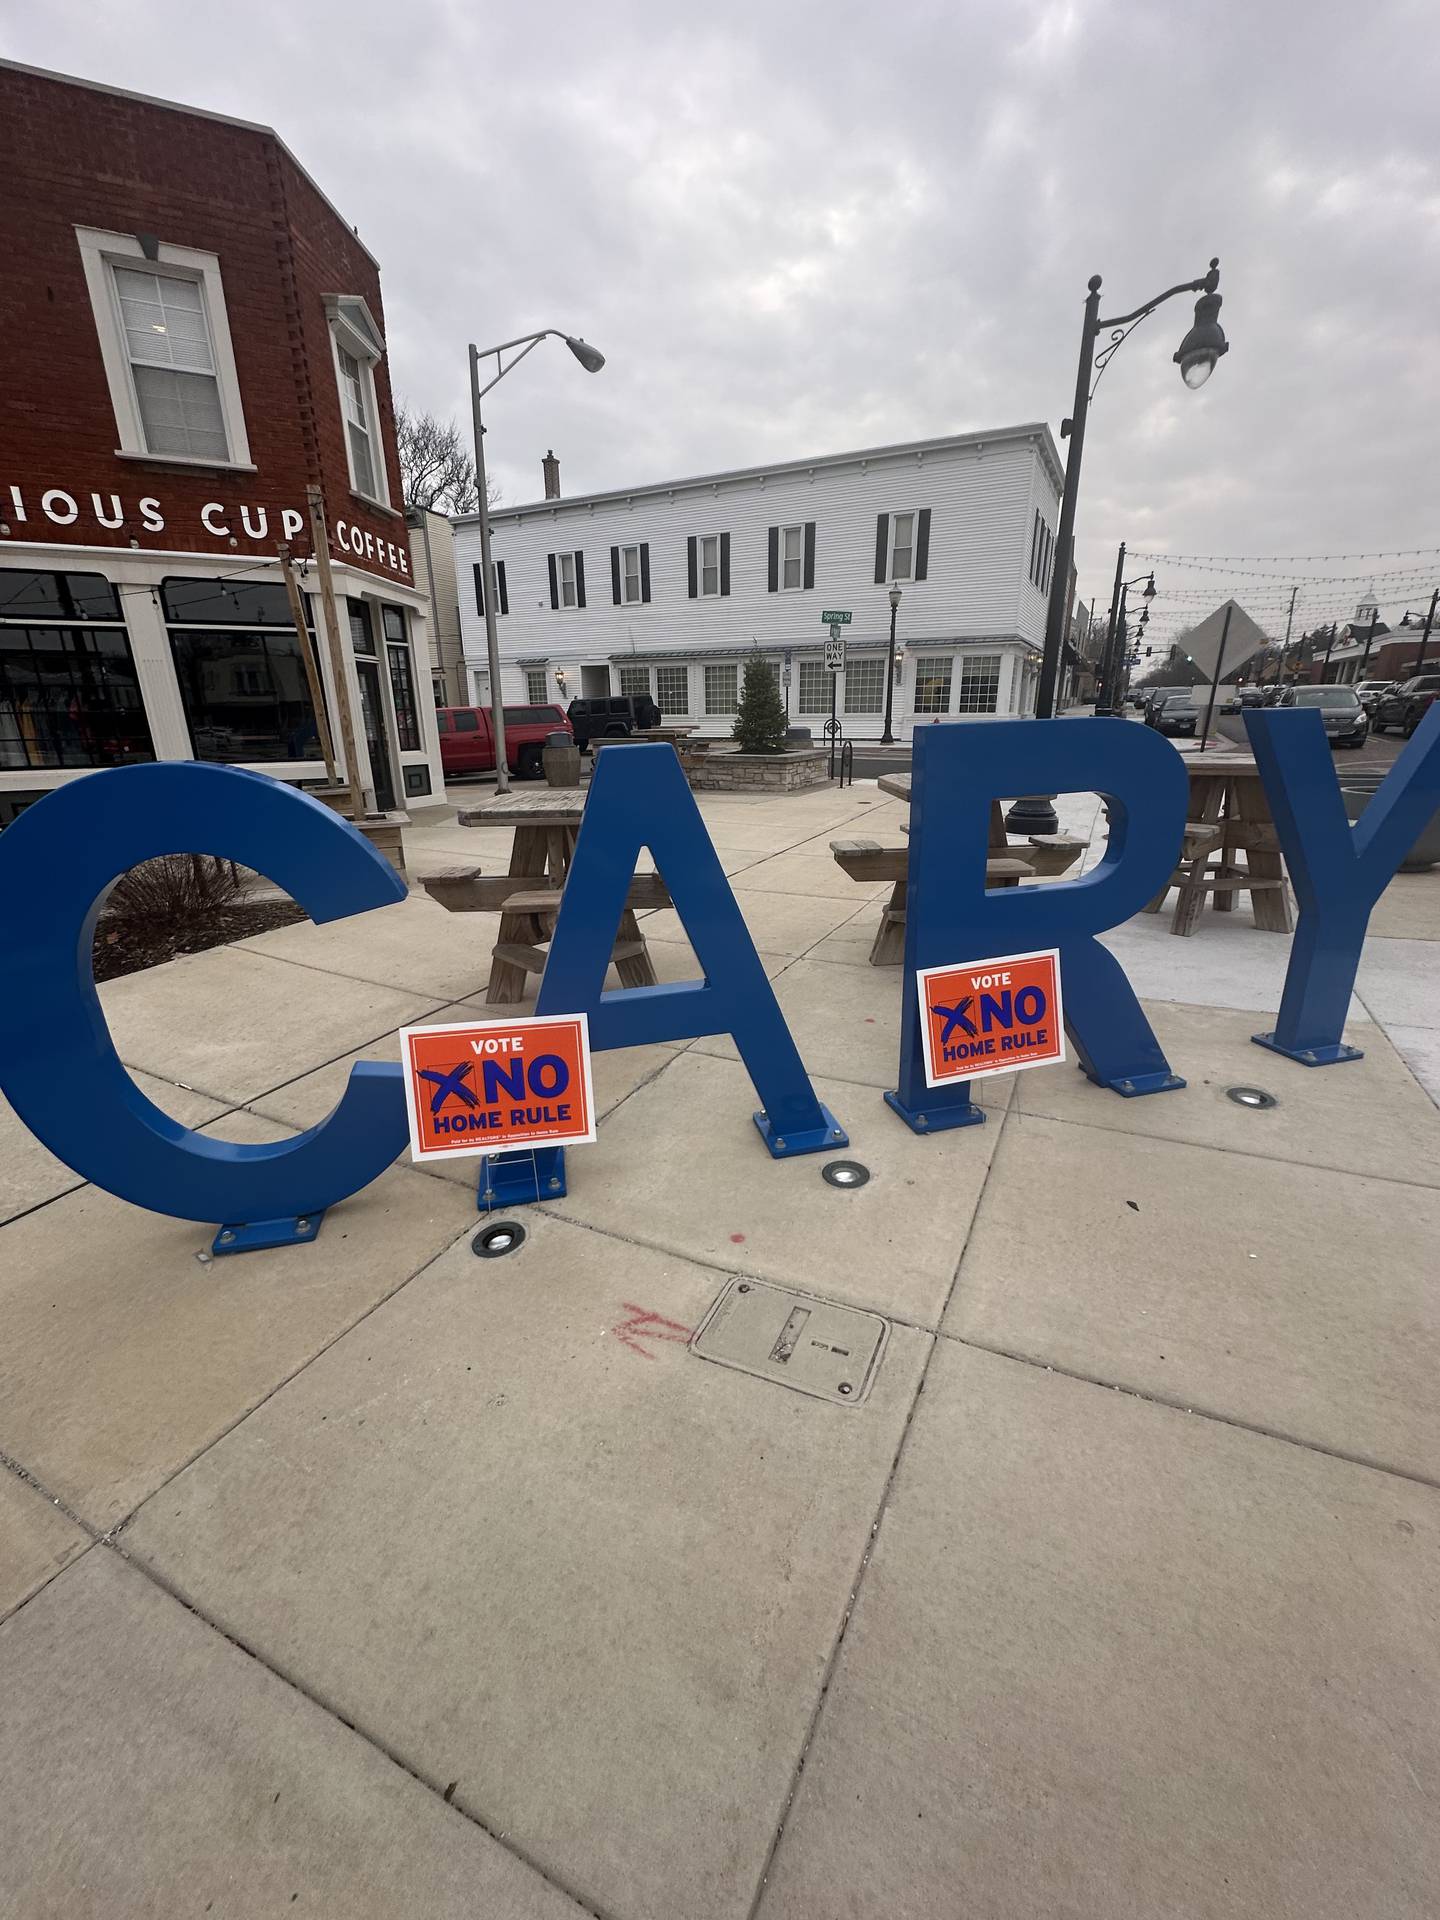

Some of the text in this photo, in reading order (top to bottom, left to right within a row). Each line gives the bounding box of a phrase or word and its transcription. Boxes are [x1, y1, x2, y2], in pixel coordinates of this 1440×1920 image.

[10, 485, 408, 573] IOUS CUP COFFEE
[823, 612, 843, 622] Spring
[826, 643, 843, 651] ONE
[826, 652, 843, 660] WAY
[0, 702, 1440, 1226] CARY
[971, 972, 1012, 990] VOTE
[980, 986, 1046, 1032] NO
[470, 1037, 524, 1055] VOTE
[943, 1039, 996, 1062] HOME
[1001, 1029, 1048, 1051] RULE
[482, 1054, 569, 1104] NO
[433, 1104, 572, 1134] HOME RULE
